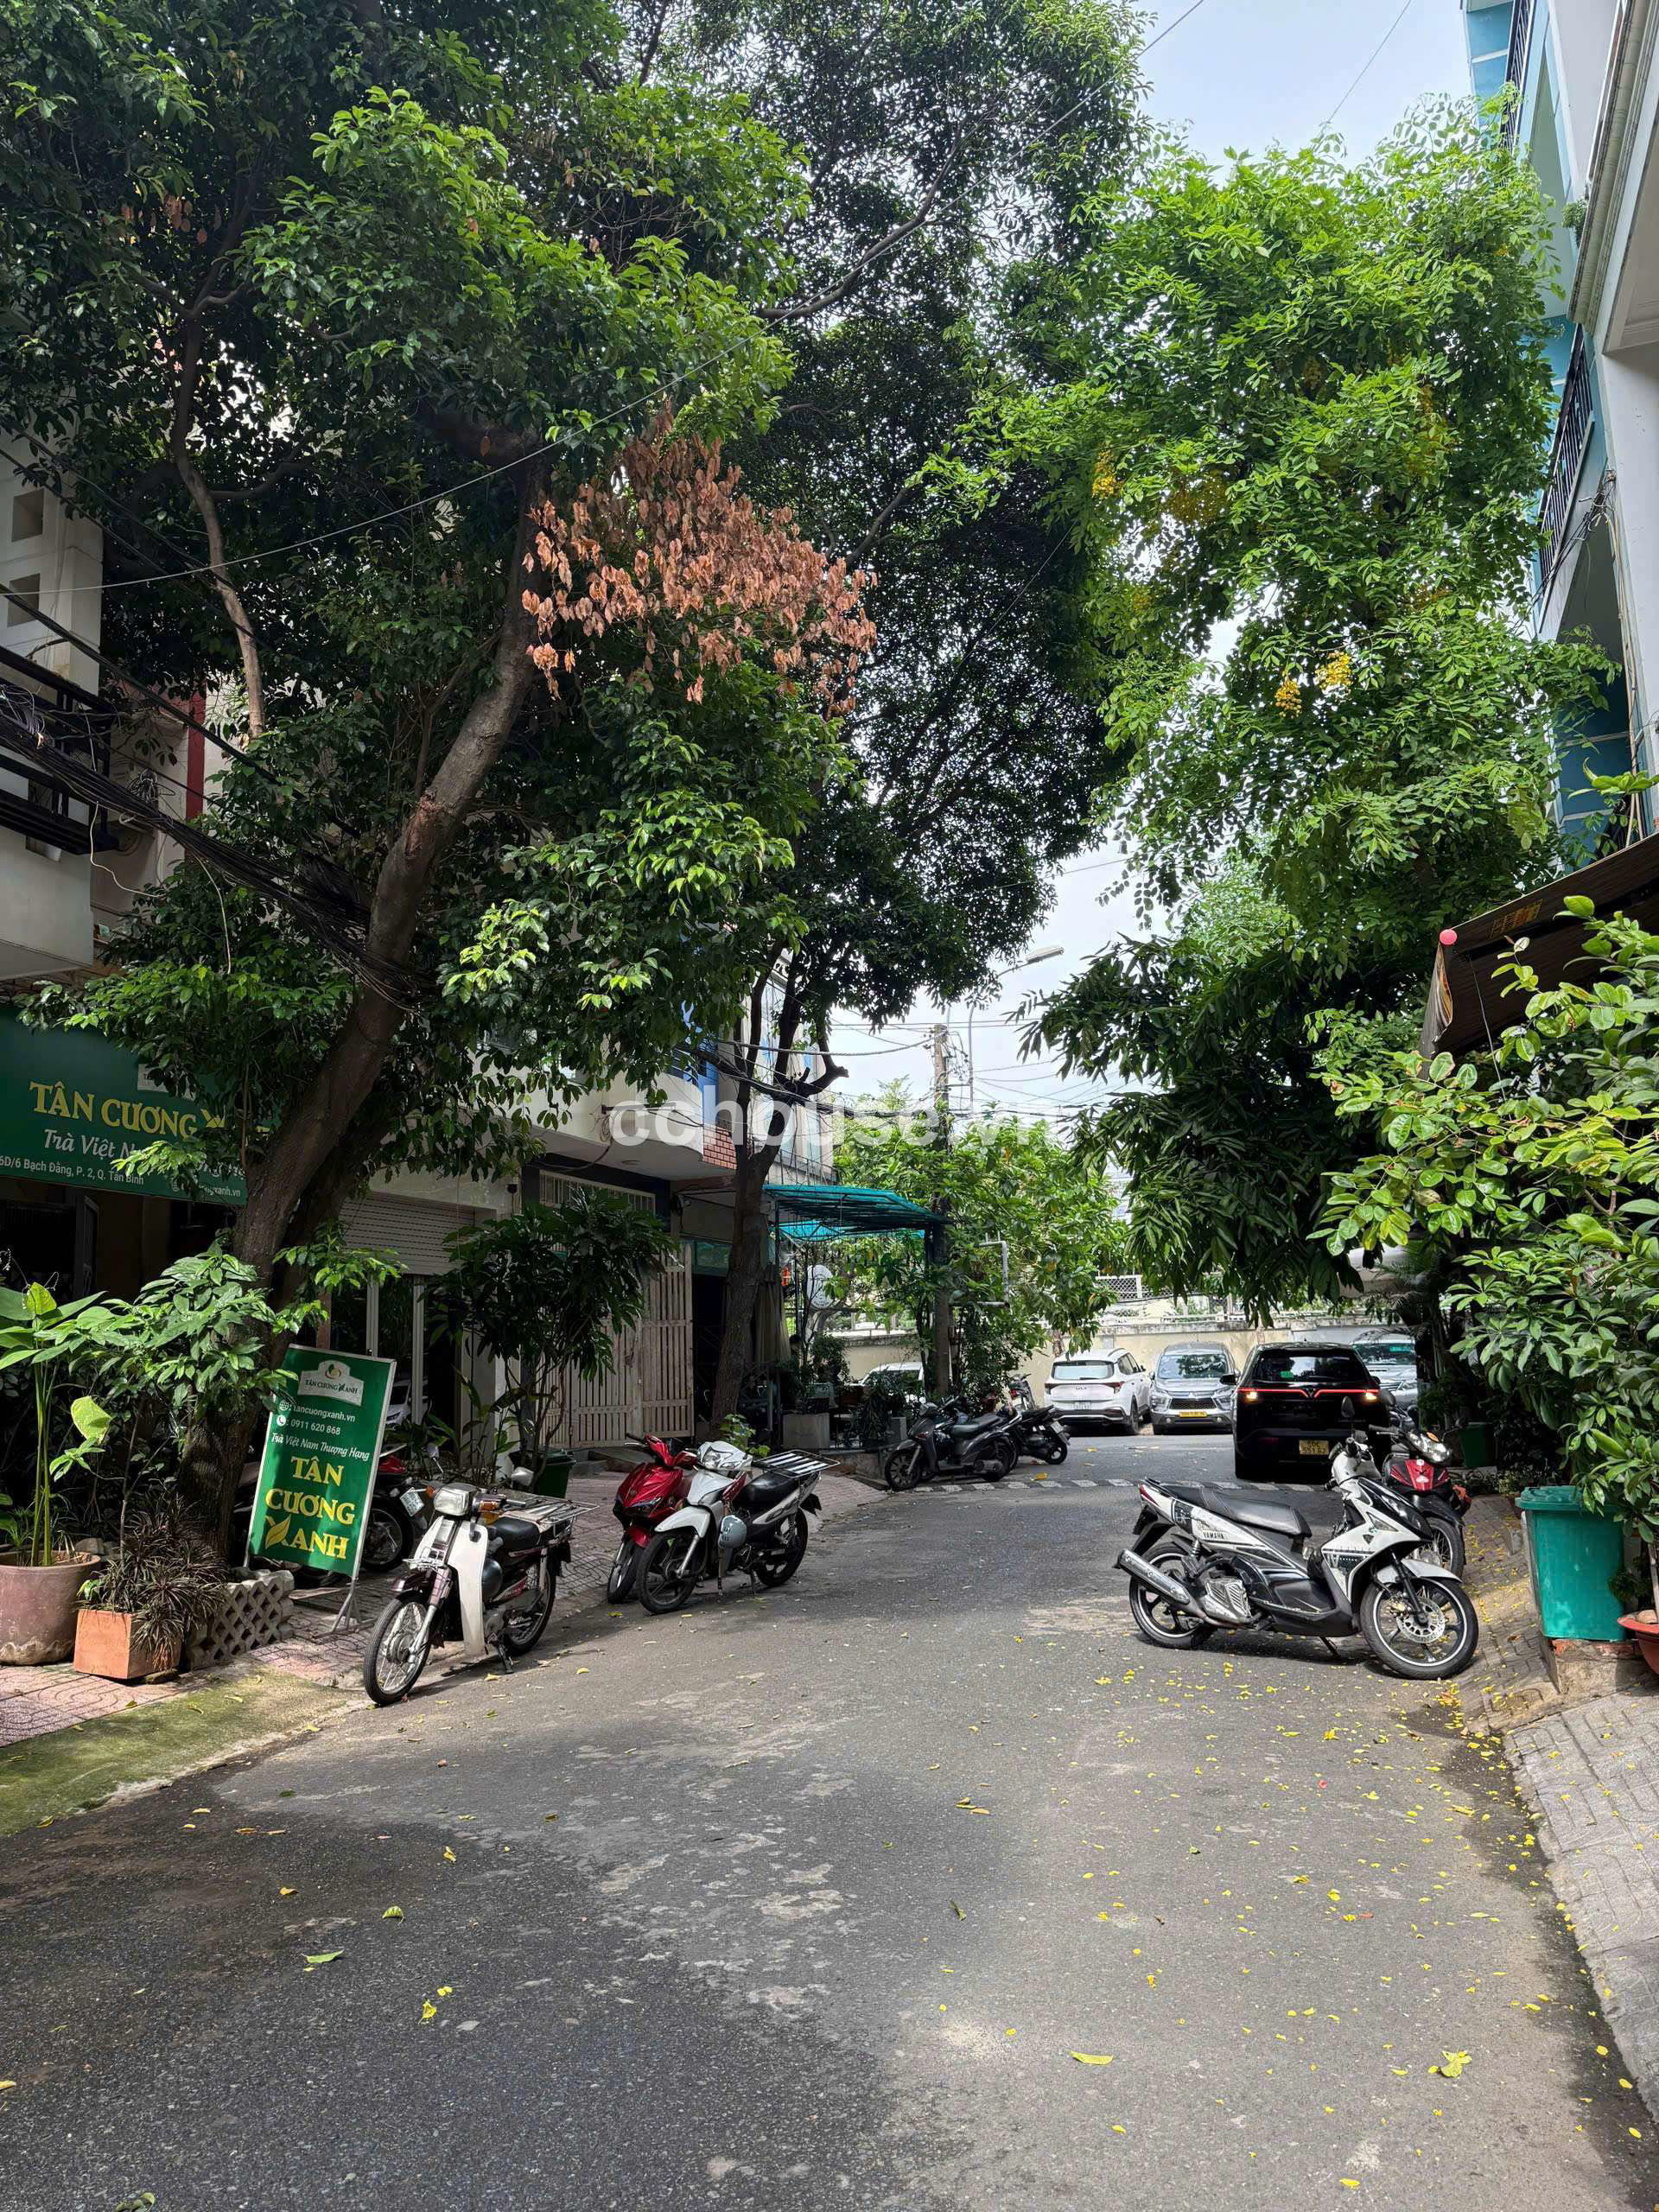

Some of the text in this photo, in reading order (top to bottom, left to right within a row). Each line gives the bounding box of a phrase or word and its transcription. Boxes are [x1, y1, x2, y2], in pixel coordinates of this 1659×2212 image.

[29, 1081, 95, 1122] TÂN
[101, 1098, 197, 1140] CƯƠNG
[44, 1128, 75, 1152] Trà
[81, 1135, 116, 1160] Việt
[24, 1159, 47, 1173] Bạch
[97, 1170, 106, 1181] Q.
[290, 1418, 341, 1436] 0911 620 868
[270, 1432, 284, 1445] Trà
[285, 1434, 301, 1448] Việt
[300, 1438, 319, 1451] Nam
[348, 1446, 371, 1462] Hạng
[290, 1454, 344, 1487] TÂN
[264, 1487, 356, 1525] CƯƠNG
